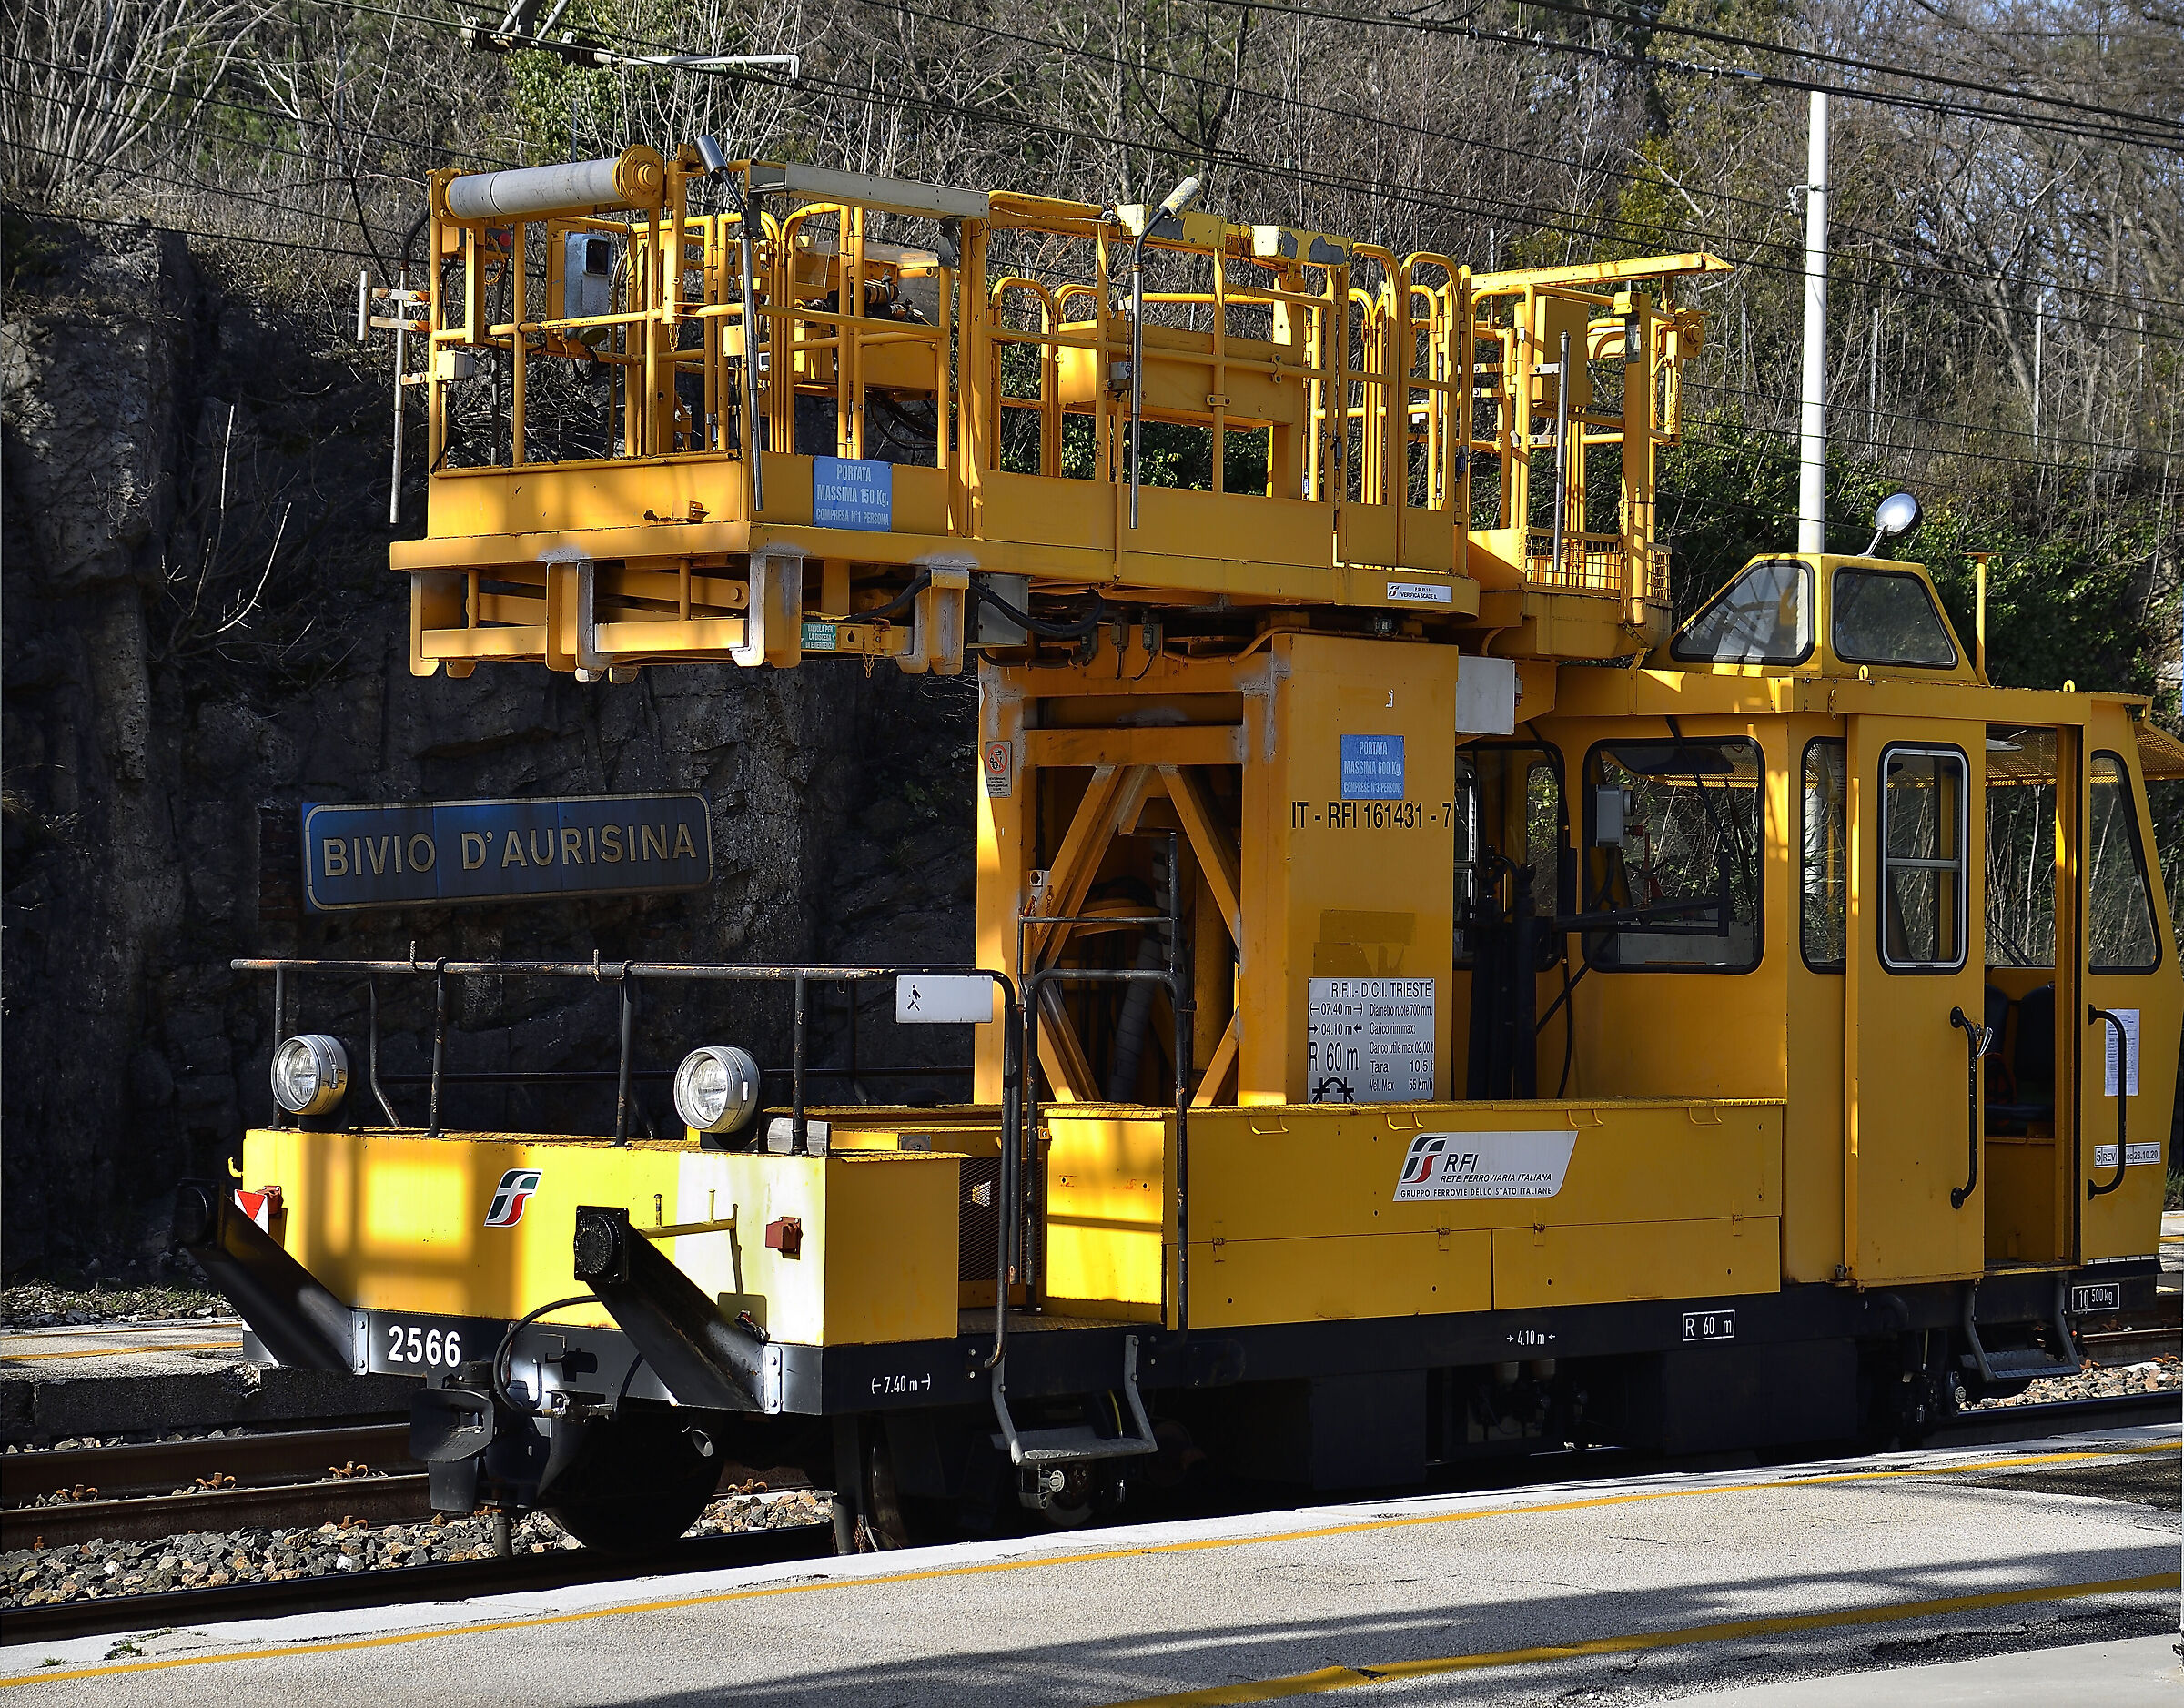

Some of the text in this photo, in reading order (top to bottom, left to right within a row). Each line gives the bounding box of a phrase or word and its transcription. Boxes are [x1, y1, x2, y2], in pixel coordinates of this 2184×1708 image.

[837, 464, 871, 482] PORTATA
[817, 484, 889, 507] MASSIMA 150 Kg.
[816, 508, 849, 522] COMPRESA
[863, 512, 889, 525] PERSONA
[1359, 741, 1387, 755] PORTATA
[1344, 760, 1402, 776] MASSIMA 600 Kg.
[1344, 782, 1369, 792] COMPRESE
[1381, 782, 1402, 793] PERSONE
[1292, 801, 1309, 829] IT
[1327, 802, 1357, 829] RFI
[1364, 802, 1423, 829] 161431
[1442, 802, 1452, 828] 7
[323, 823, 697, 876] BIVIO D'AURISINA
[1361, 982, 1387, 998] D.C.I.
[1390, 982, 1431, 998] TRIESTE
[1321, 1003, 1352, 1015] 07.40 m
[1370, 1003, 1394, 1016] Diametro
[1395, 1004, 1409, 1016] ruote
[1321, 1023, 1352, 1035] 04.10 m
[1370, 1022, 1389, 1035] Carico
[1390, 1022, 1400, 1034] rim
[1370, 1041, 1388, 1054] Carico
[1389, 1041, 1401, 1053] utile
[1402, 1044, 1414, 1053] max
[1309, 1042, 1359, 1072] R 60 m
[1370, 1061, 1389, 1073] Tara
[1410, 1060, 1428, 1074] 10,5
[1370, 1078, 1433, 1091] Vel. Max 55 Km/h
[1443, 1153, 1479, 1173] RFI
[2096, 1151, 2101, 1162] 5
[2103, 1153, 2116, 1162] REV
[1463, 1174, 1515, 1183] FERROVIARIA
[1520, 1187, 1551, 1195] ITALIANE
[2079, 1289, 2113, 1308] 10 500 kg
[1685, 1316, 1732, 1337] R 60 m
[387, 1325, 461, 1367] 2566
[1517, 1330, 1545, 1346] 4.10 m
[885, 1375, 918, 1393] 7.40 m
